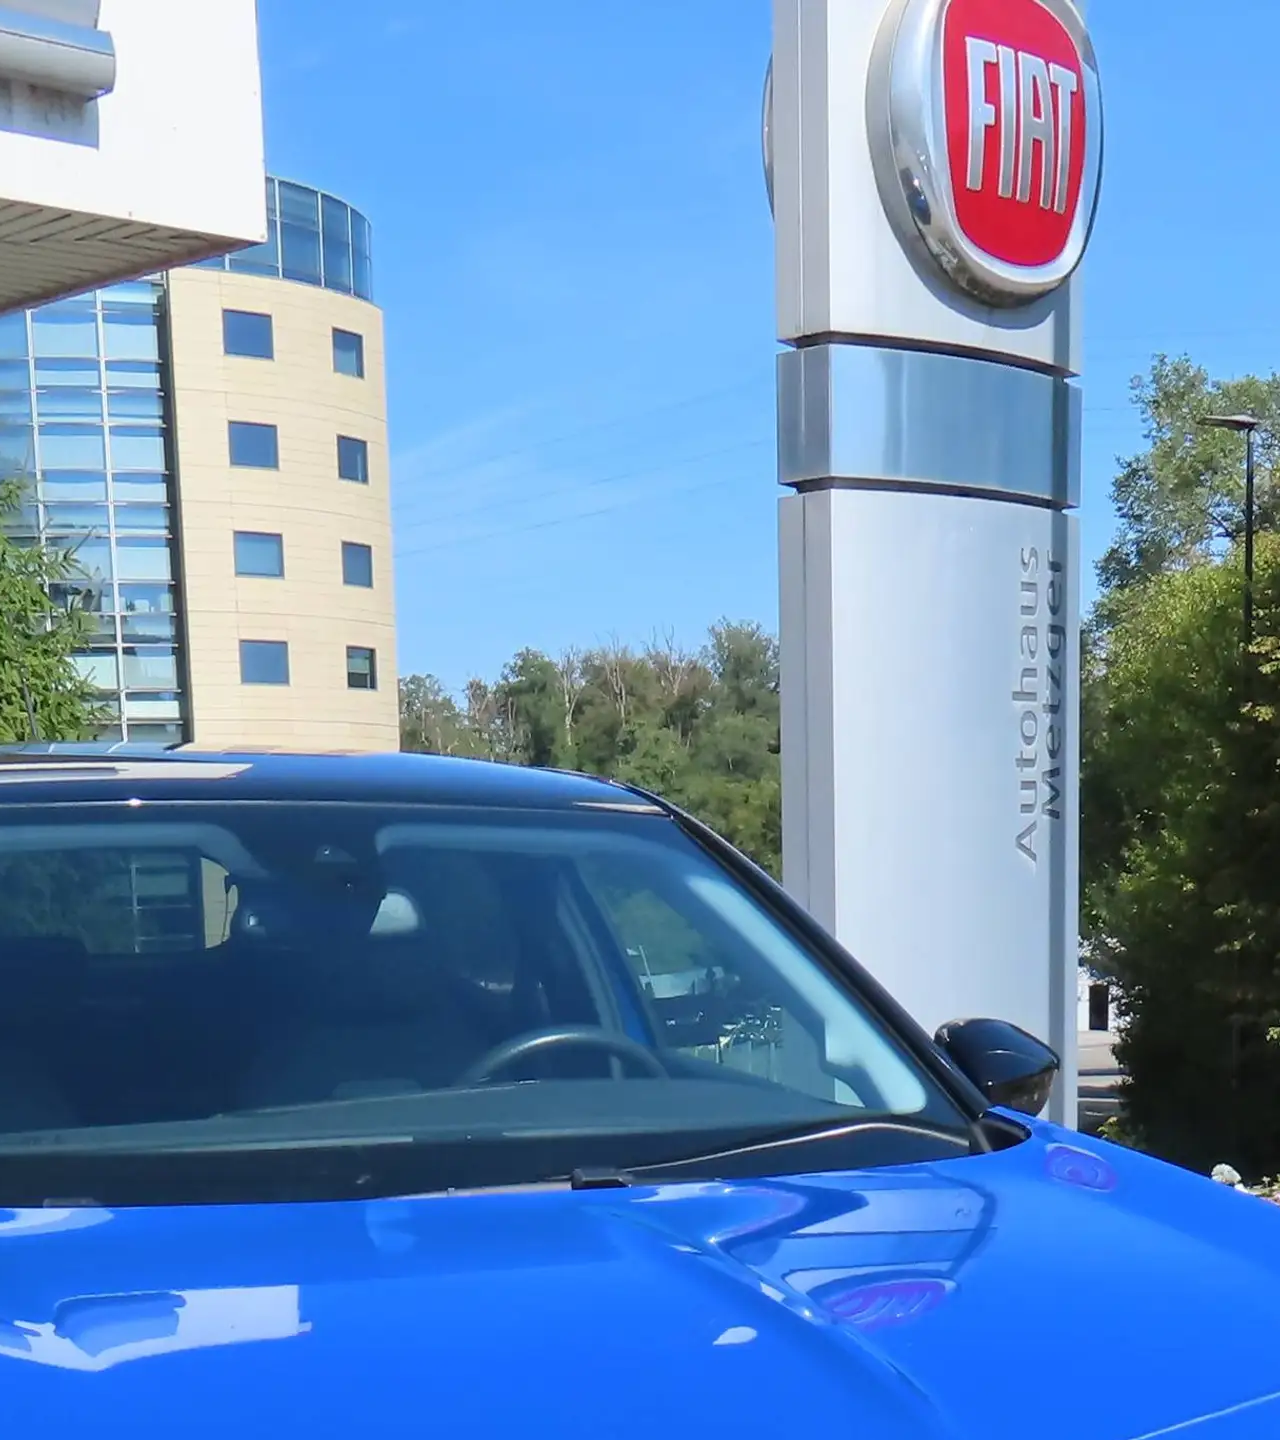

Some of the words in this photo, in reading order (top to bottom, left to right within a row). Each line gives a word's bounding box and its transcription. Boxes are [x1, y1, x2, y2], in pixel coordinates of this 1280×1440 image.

[965, 36, 1077, 215] FIAT
[1011, 546, 1039, 864] Autohaus
[1040, 550, 1066, 820] Metzger
